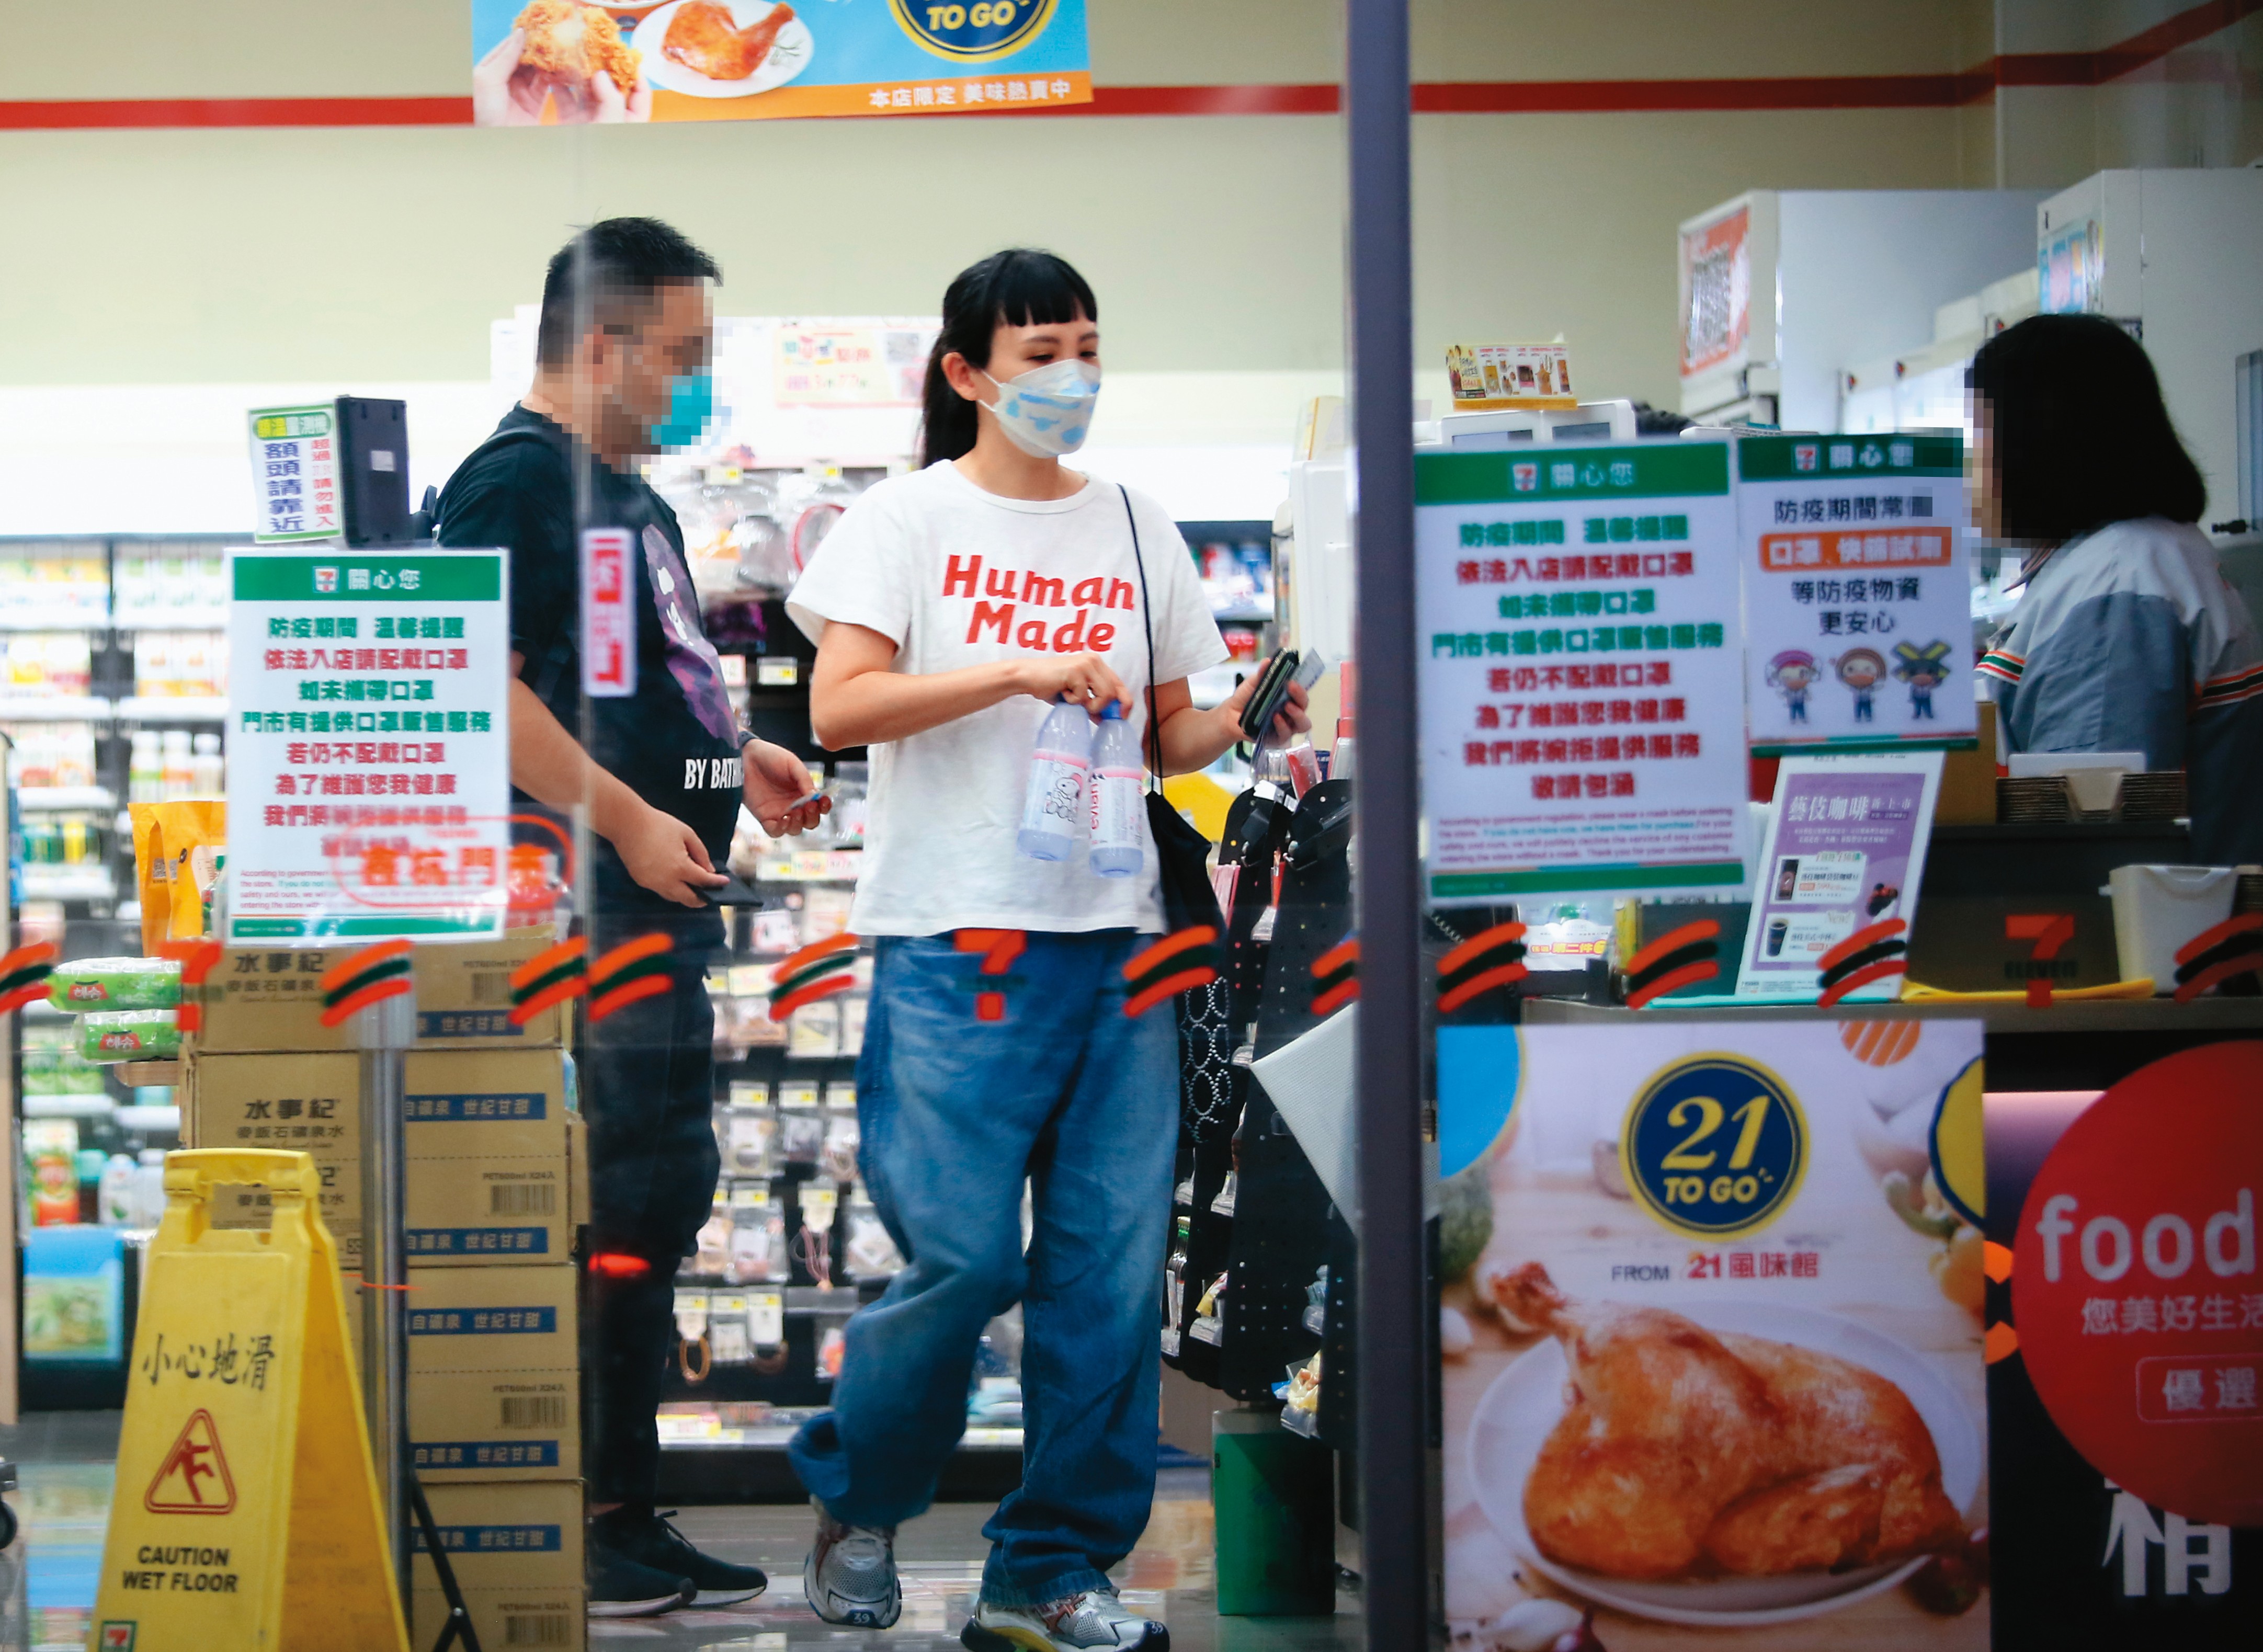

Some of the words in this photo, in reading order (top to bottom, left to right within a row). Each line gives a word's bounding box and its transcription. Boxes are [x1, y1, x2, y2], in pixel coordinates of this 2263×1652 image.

[927, 5, 966, 30] TO
[970, 2, 1016, 27] GO
[869, 86, 956, 108] 本店限定
[964, 78, 1071, 103] 美味熱賣中
[265, 441, 304, 533] 額頭請靠近
[348, 568, 420, 590] 關心您
[943, 555, 1135, 610] Human
[1792, 577, 1919, 603] 等防疫物資
[268, 618, 357, 637] 防疫期間
[374, 618, 464, 637] 溫馨提醒
[966, 601, 1116, 653] Made
[1820, 610, 1893, 635] 更安心
[265, 649, 468, 670] 依法入店請配戴口罩
[299, 680, 434, 700] 如未攜帶口罩
[287, 743, 445, 764] 若仍不配戴口罩
[276, 774, 456, 795] 為了維護您我健康
[684, 759, 708, 789] BY
[235, 953, 324, 973] 水事紀
[245, 1099, 336, 1119] 水事紀
[464, 1099, 529, 1114] 世紀甘甜
[1661, 1096, 1770, 1169] 21
[1664, 1178, 1705, 1203] TO
[1710, 1178, 1759, 1203] GO
[465, 1233, 532, 1249] 世紀甘甜
[2036, 1188, 2256, 1282] food
[1612, 1266, 1669, 1281] FROM
[1730, 1252, 1819, 1278] 風味館
[474, 1312, 540, 1328] 世紀甘甜
[143, 1333, 275, 1391] 小心地滑
[2162, 1366, 2257, 1411] 優選
[476, 1446, 542, 1462] 世紀甘甜
[138, 1545, 229, 1566] CAUTION
[123, 1571, 165, 1590] WET
[170, 1574, 238, 1593] FLOOR
[854, 1612, 870, 1623] 39
